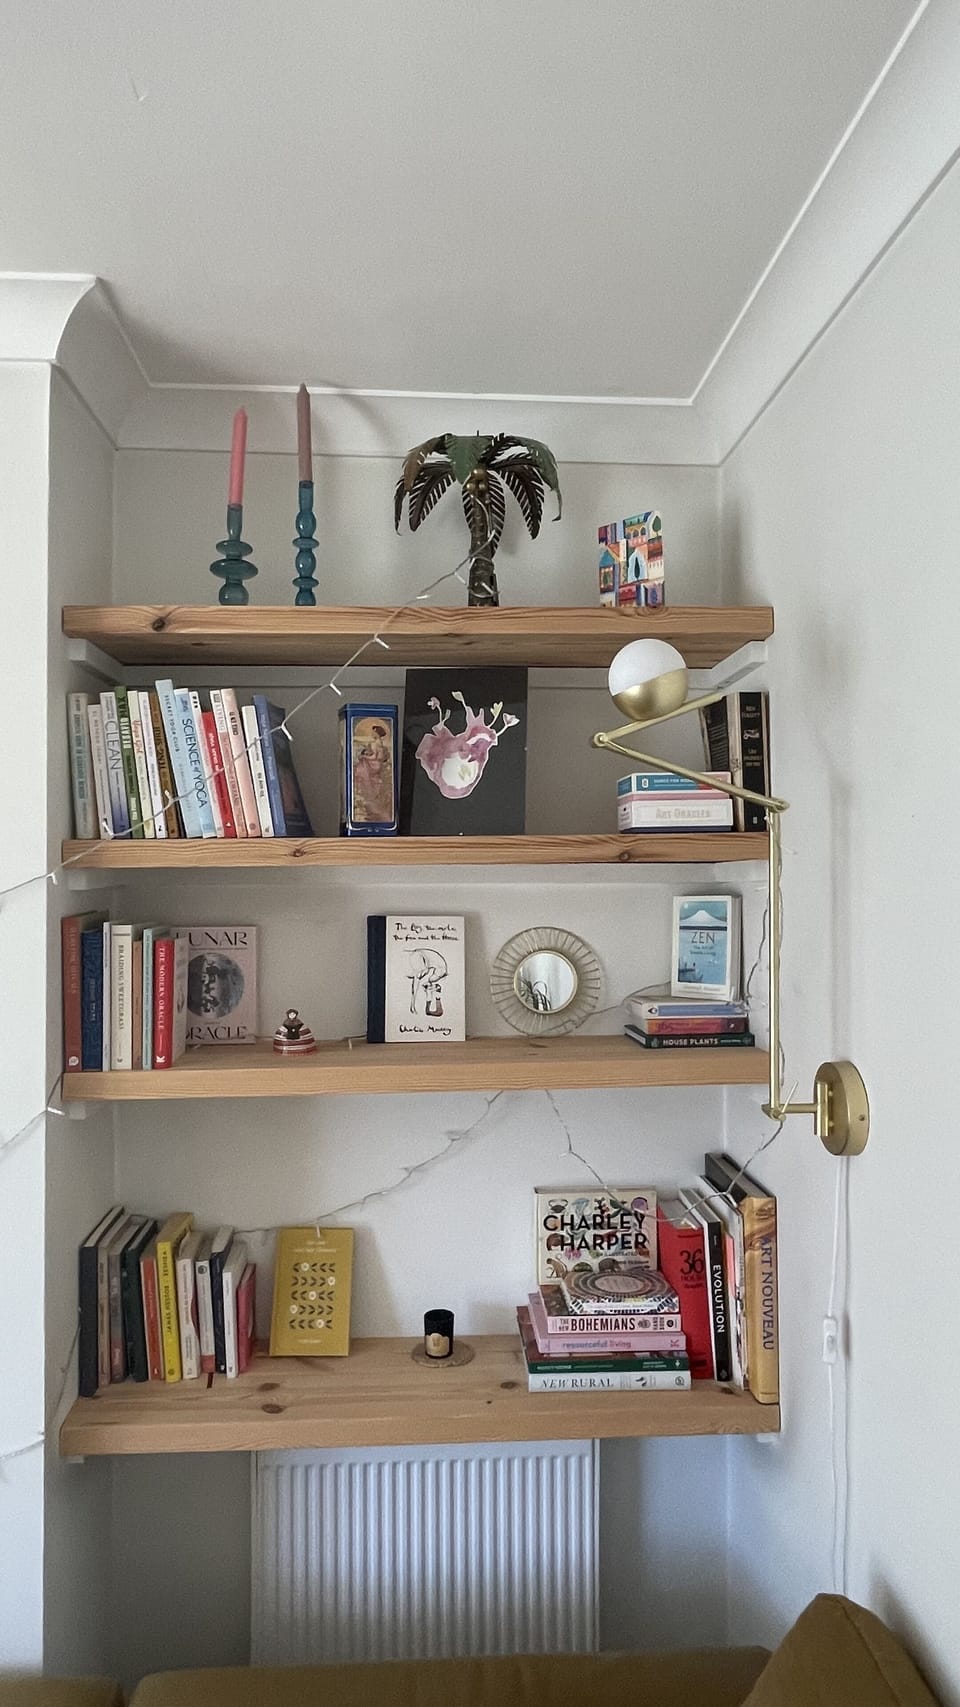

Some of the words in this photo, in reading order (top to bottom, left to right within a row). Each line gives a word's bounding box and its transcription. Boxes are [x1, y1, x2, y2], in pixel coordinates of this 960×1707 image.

[163, 694, 173, 716] SECRET
[214, 703, 226, 730] LIVING
[168, 718, 177, 735] YOGA
[104, 720, 122, 770] CLEAN
[172, 736, 180, 752] CLUB
[181, 717, 200, 765] SCIENCE
[192, 773, 208, 807] YOGA
[692, 932, 716, 944] ZEN
[186, 1026, 248, 1040] RACLE
[543, 1213, 646, 1232] CHARLEY
[560, 1234, 648, 1251] HARPER
[760, 1235, 772, 1266] ART
[680, 1249, 704, 1275] 36
[712, 1264, 724, 1333] EVOLUTION
[762, 1271, 774, 1350] NOUVEAU
[571, 1318, 636, 1331] BOHEMIANS
[562, 1340, 608, 1349] resourceful
[608, 1340, 632, 1349] living
[540, 1379, 570, 1388] NEW
[571, 1378, 614, 1388] RURAL
